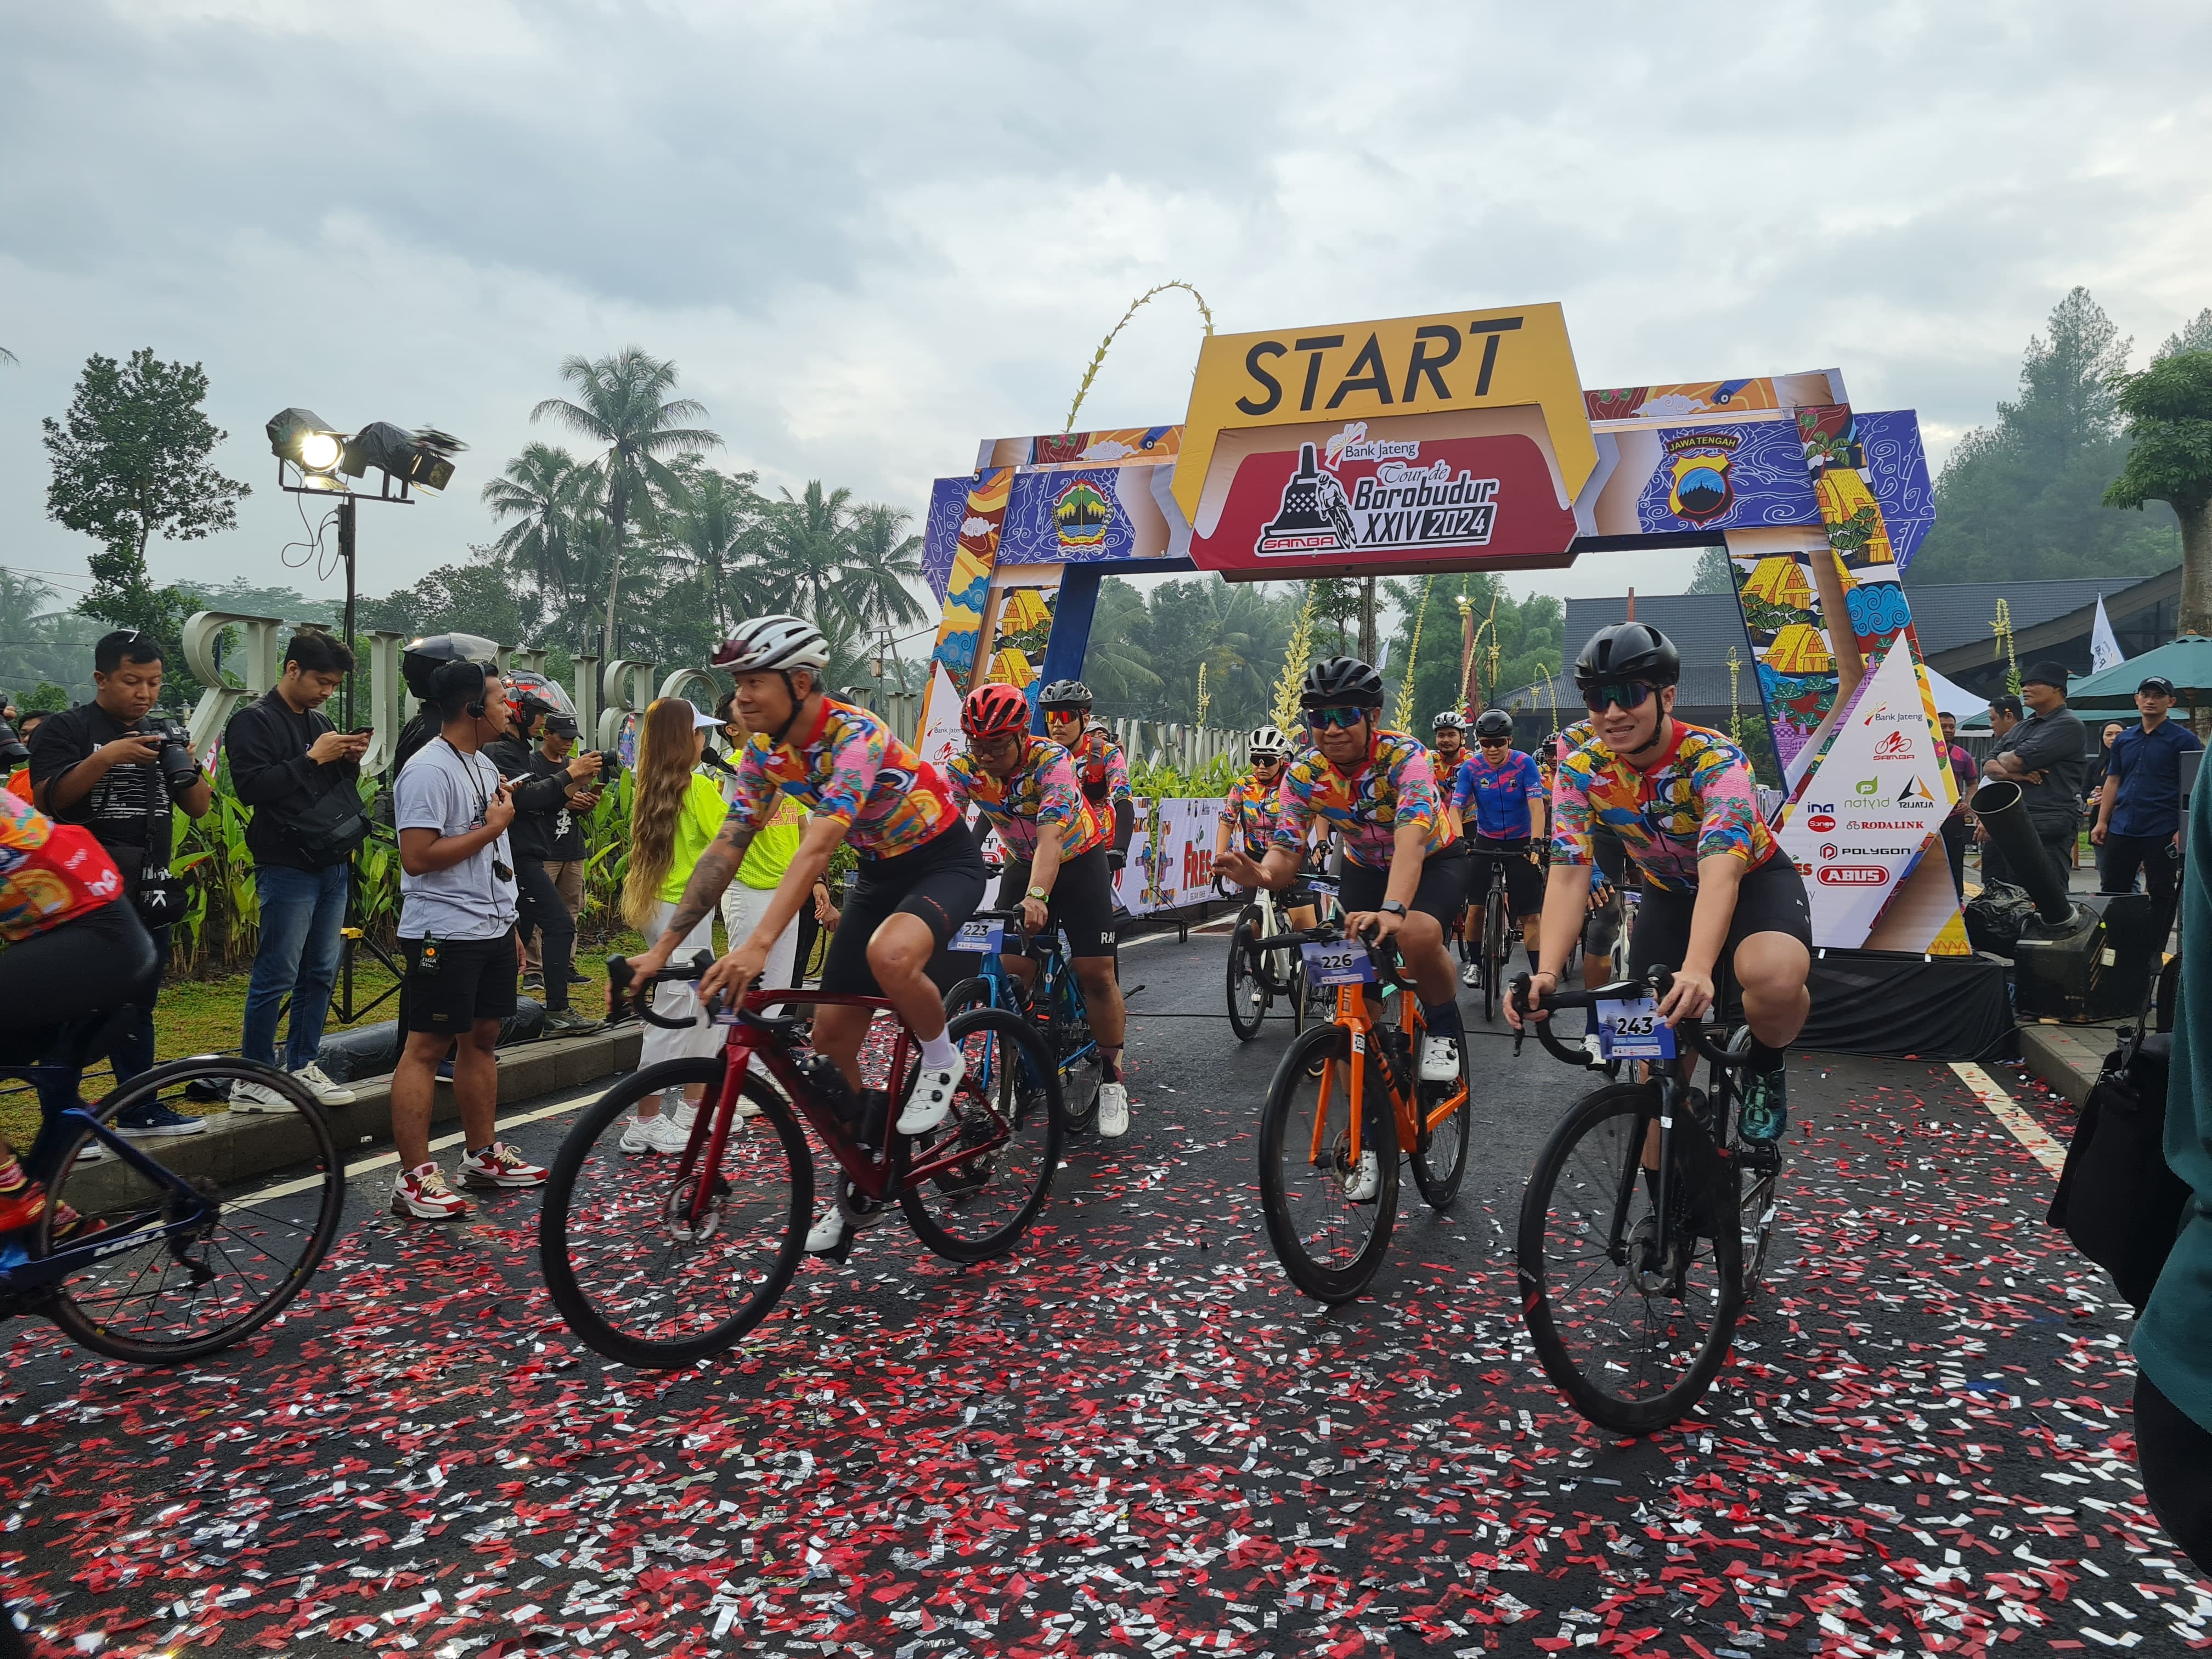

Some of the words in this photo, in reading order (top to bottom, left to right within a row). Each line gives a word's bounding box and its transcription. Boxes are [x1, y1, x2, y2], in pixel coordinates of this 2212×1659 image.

[1235, 316, 1523, 415] START
[1345, 443, 1375, 457] Bank
[1377, 443, 1415, 458] Jateng
[1669, 438, 1695, 451] JAWA
[1696, 437, 1736, 447] TENGAH
[1380, 464, 1425, 483] Tour
[1428, 463, 1447, 480] de
[1354, 473, 1496, 511] Borobudur
[1362, 510, 1422, 543] XXIV
[1427, 509, 1486, 537] 2024
[1265, 537, 1334, 549] SAMBA
[1897, 713, 1923, 722] Jateng
[1808, 802, 1835, 813] ina
[1861, 821, 1925, 830] RODALINK
[1826, 870, 1880, 881] ABUS
[962, 924, 989, 936] 223
[1322, 954, 1352, 968] 226
[1617, 1017, 1654, 1035] 243
